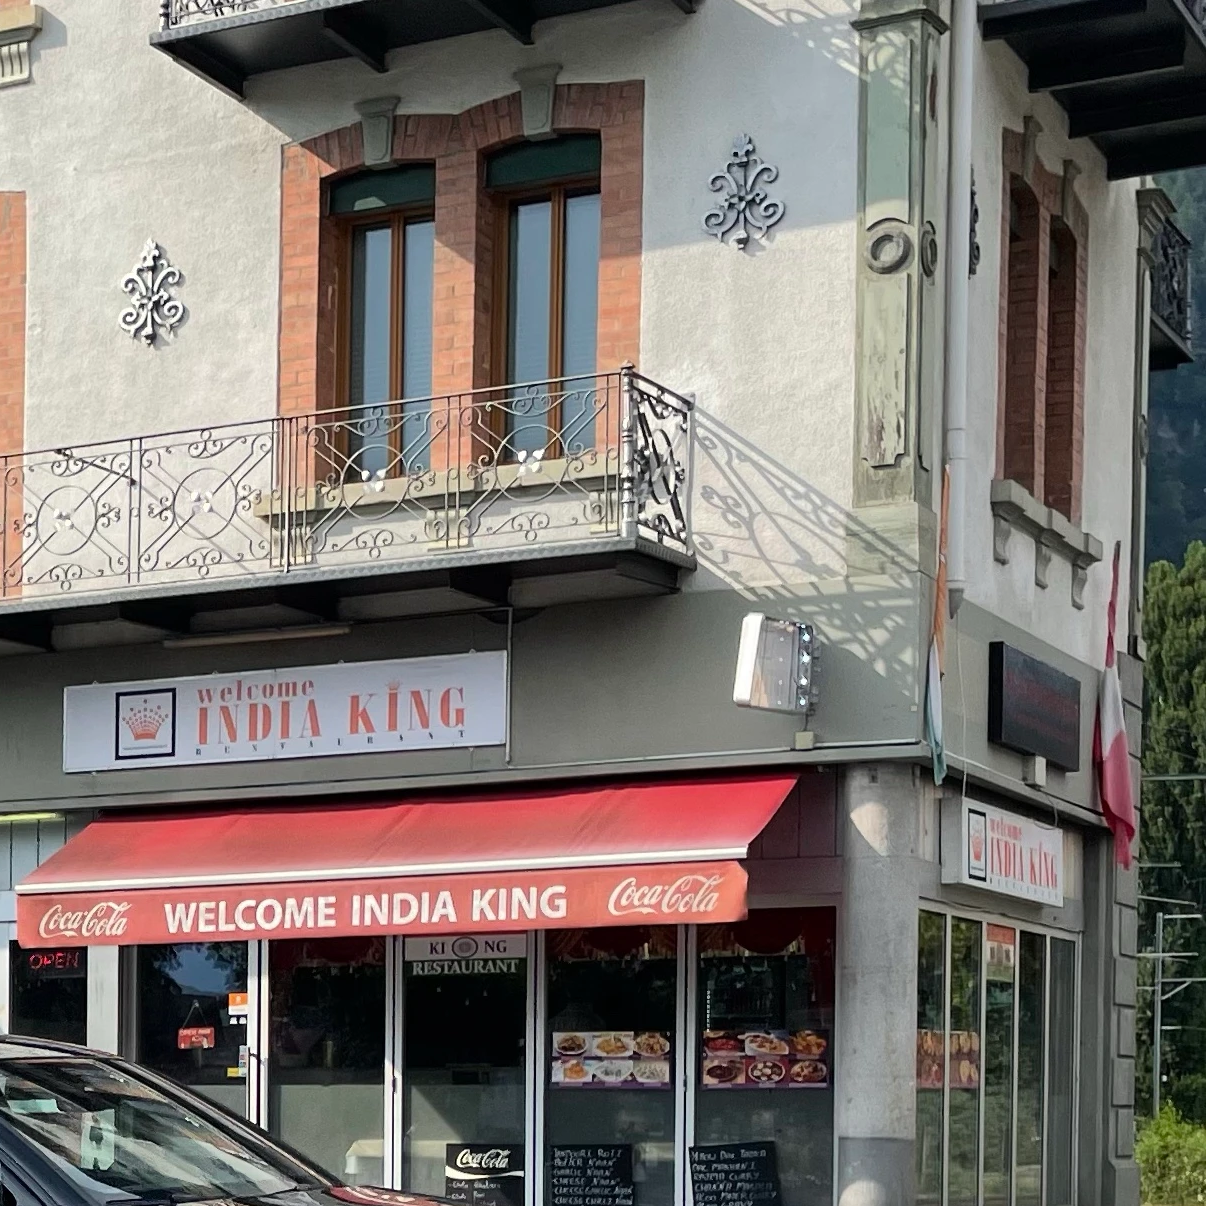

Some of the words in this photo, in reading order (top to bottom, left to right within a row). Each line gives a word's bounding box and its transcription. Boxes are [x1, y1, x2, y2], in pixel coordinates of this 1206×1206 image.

[197, 679, 314, 704] welcome
[198, 698, 321, 745] INDIA
[347, 685, 465, 735] KING
[164, 896, 336, 933] WELCOME
[351, 891, 457, 926] INDIA
[471, 886, 567, 922] KING
[607, 875, 724, 916] Coca-Cola
[39, 902, 132, 938] Coca-Cola
[29, 952, 80, 969] OPEN
[412, 959, 520, 976] RESTAURANT
[456, 1148, 512, 1169] Coca-Cola
